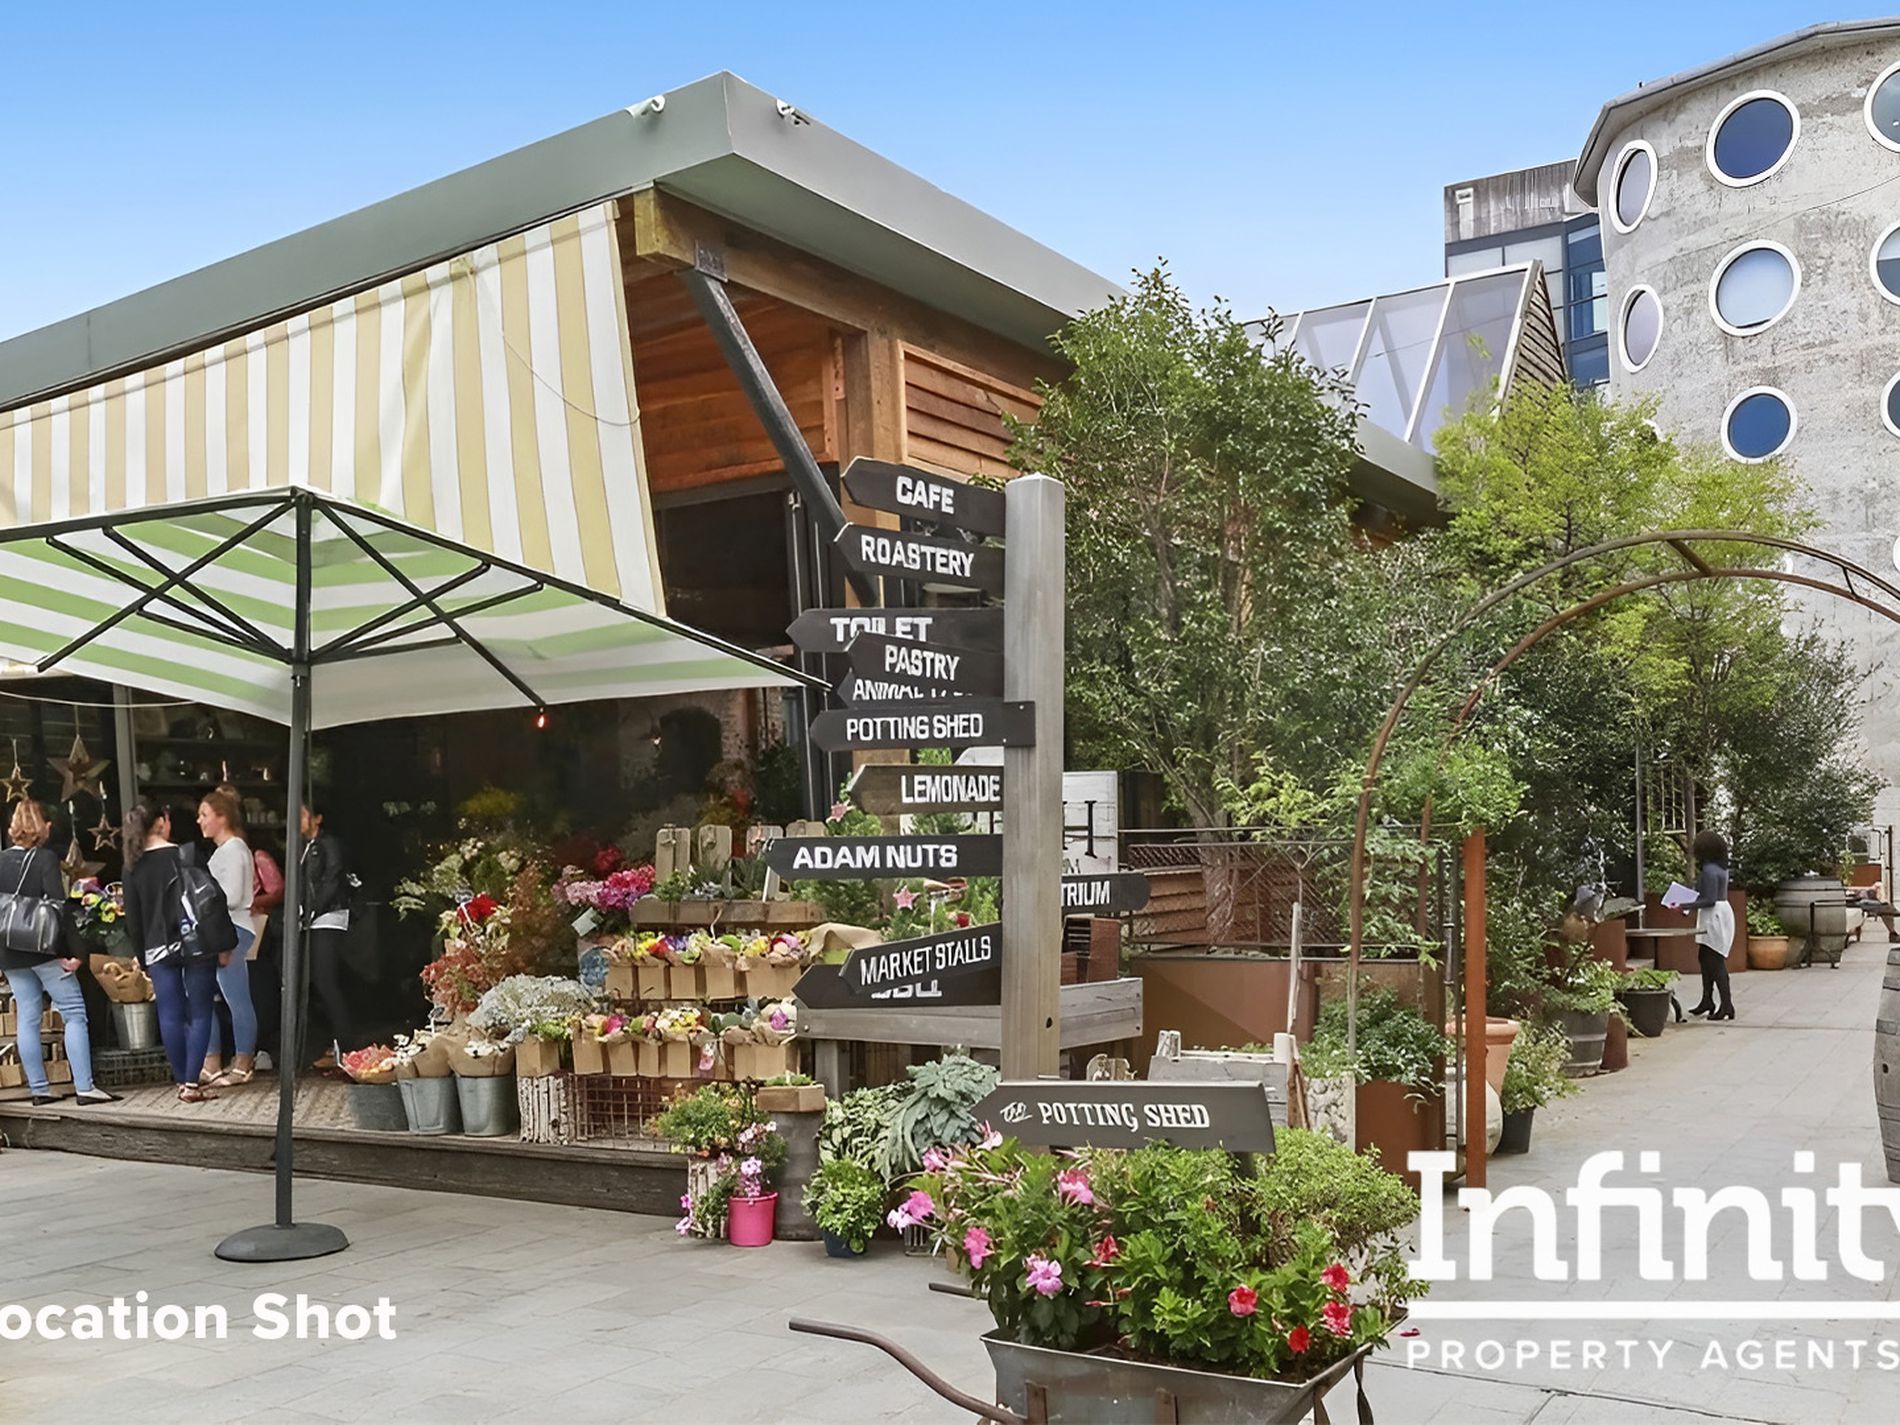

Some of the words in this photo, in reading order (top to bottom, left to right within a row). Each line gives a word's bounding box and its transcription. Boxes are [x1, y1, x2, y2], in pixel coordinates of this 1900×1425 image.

[896, 475, 955, 515] CAFE
[861, 534, 974, 578] ROASTERY
[884, 645, 960, 681] PASTRY
[846, 715, 929, 742] POTTING
[933, 713, 984, 738] SHED
[901, 774, 1000, 804] LEMONADE
[792, 846, 880, 869] ADAM
[886, 844, 958, 869] NUTS
[860, 948, 931, 987] MARKET
[935, 935, 992, 970] STALLS
[1037, 1102, 1138, 1132] POTTING
[1143, 1103, 1211, 1128] SHED
